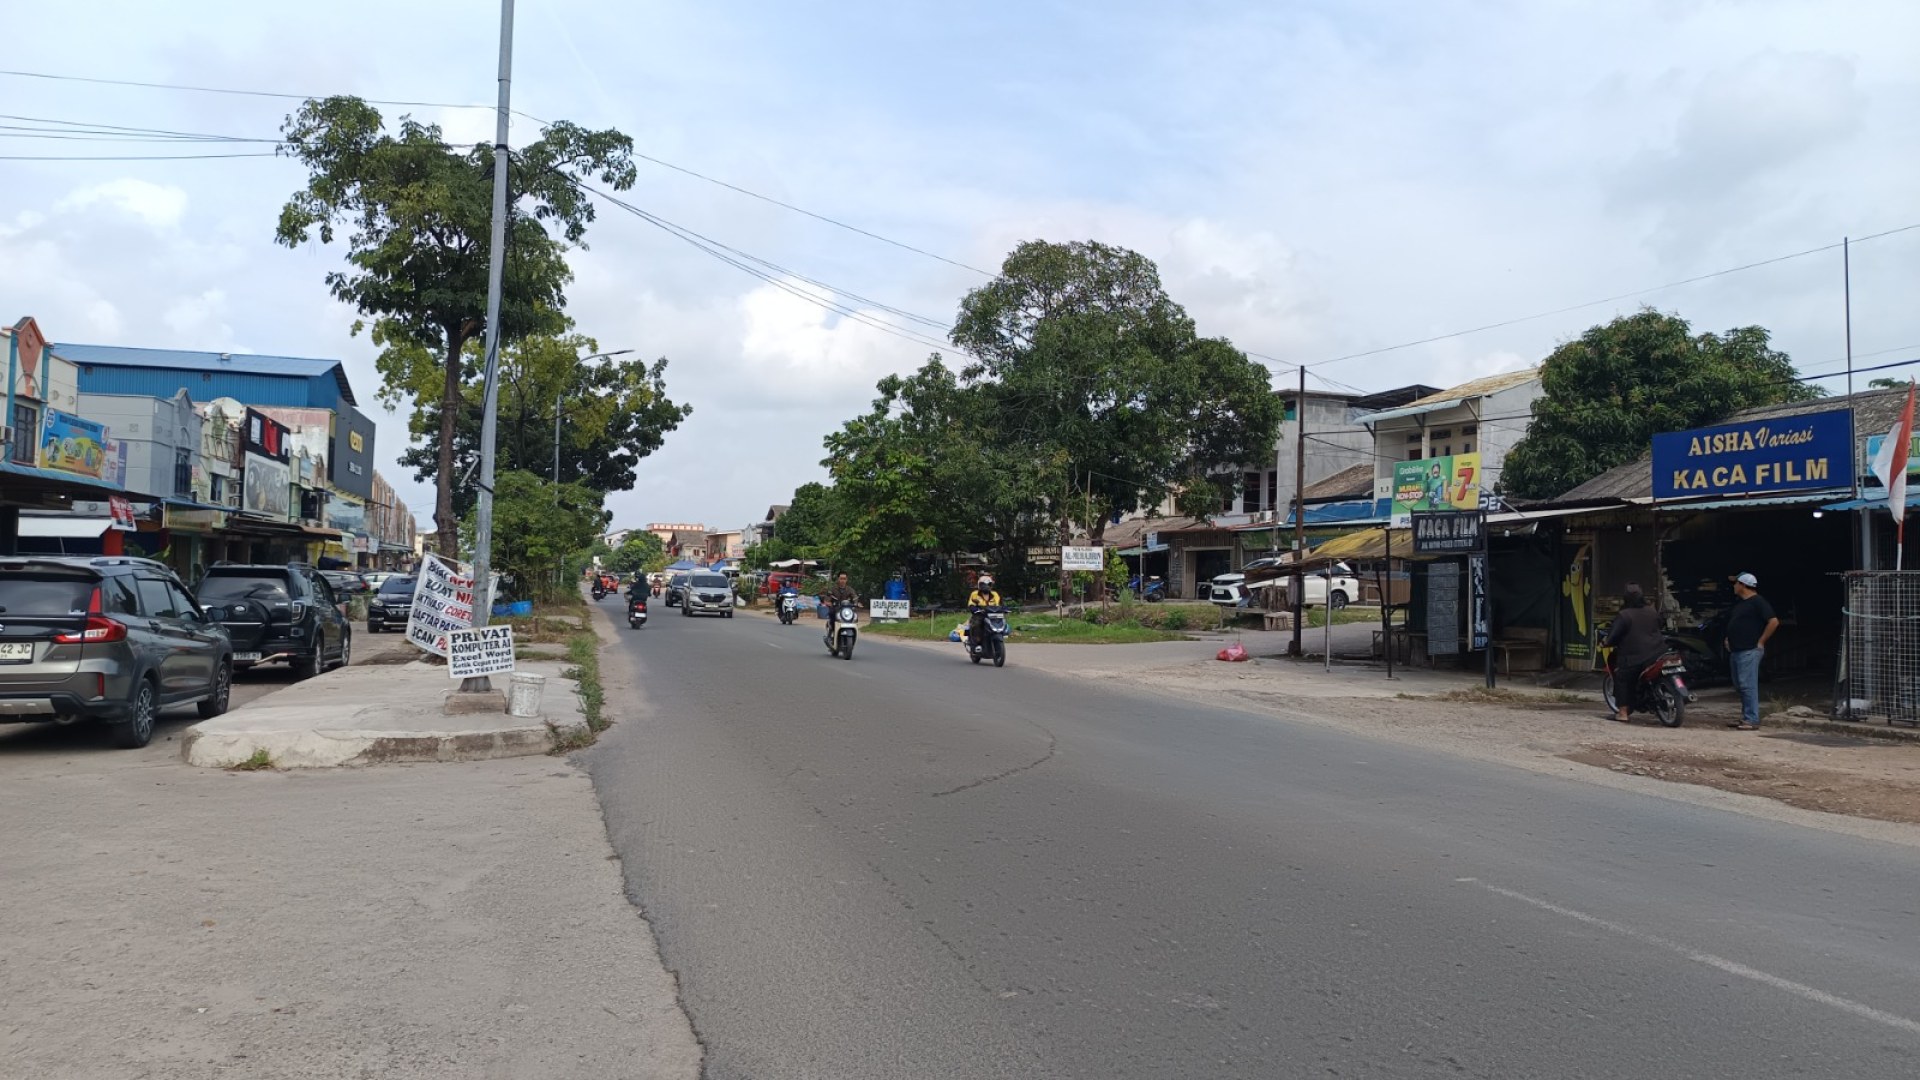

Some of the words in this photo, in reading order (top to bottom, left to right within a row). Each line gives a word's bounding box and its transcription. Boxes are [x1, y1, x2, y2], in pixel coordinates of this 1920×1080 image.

[1688, 429, 1756, 457] AISHA
[1756, 425, 1814, 450] Variasi
[1673, 464, 1748, 490] KACA
[1755, 457, 1829, 486] FILM
[1456, 467, 1475, 501] 7
[1417, 518, 1450, 539] KACA
[1453, 517, 1478, 538] FILM
[425, 578, 453, 598] BUAT
[412, 608, 440, 629] DAFTAR
[411, 625, 436, 645] SCAN
[451, 627, 510, 644] PRIVAT
[451, 640, 500, 654] KOMPUTER
[452, 653, 482, 662] Excel
[486, 649, 512, 658] Word
